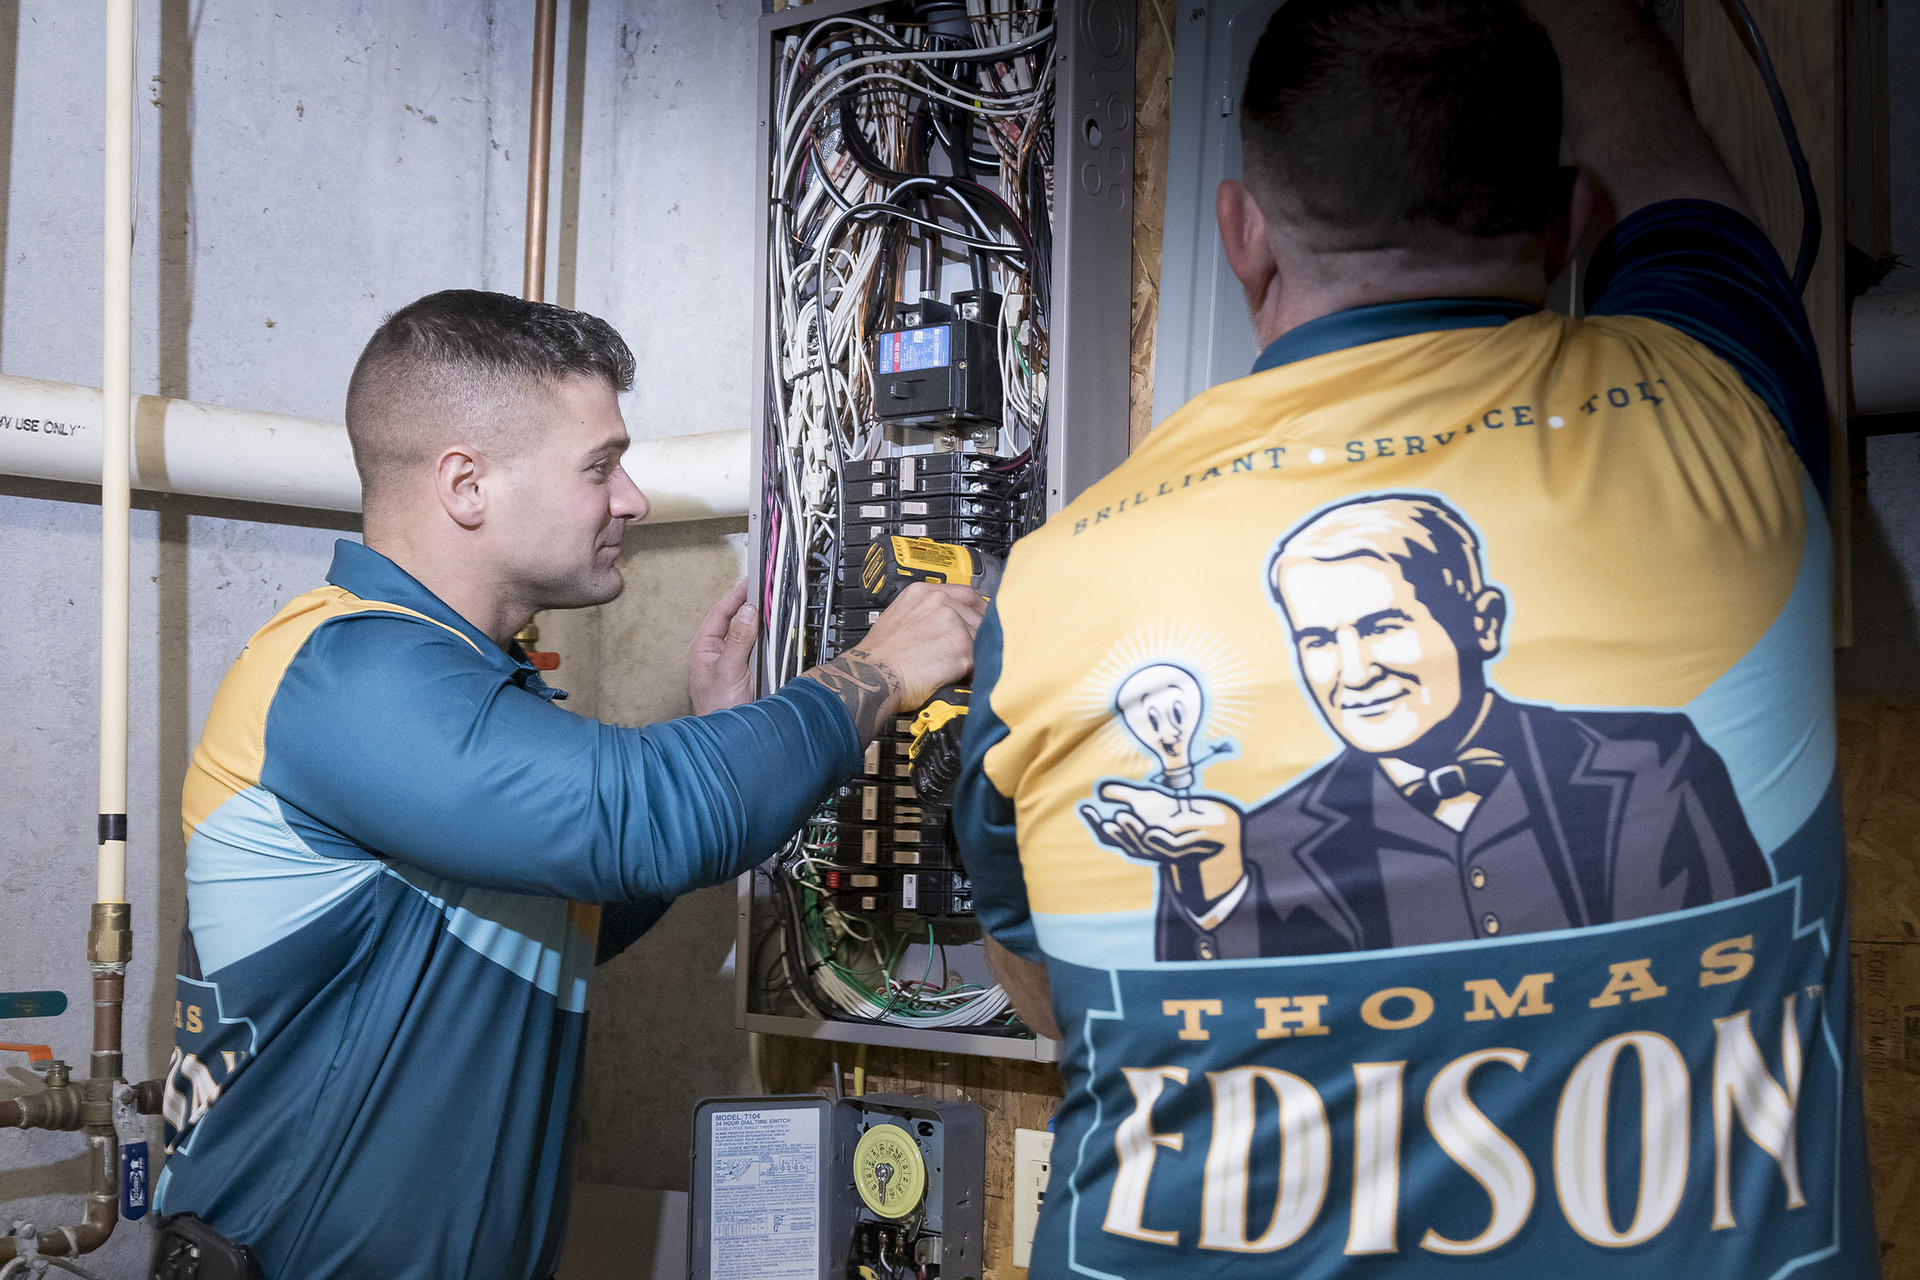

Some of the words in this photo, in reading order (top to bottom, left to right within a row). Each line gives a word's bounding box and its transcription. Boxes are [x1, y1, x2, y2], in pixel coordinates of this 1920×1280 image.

[15, 417, 40, 432] USE
[1072, 446, 1288, 537] BRILLIANT
[1346, 405, 1534, 463] SERVICE
[1162, 935, 1756, 1042] THOMAS
[716, 1113, 743, 1121] MODEL:
[1101, 995, 1807, 1257] EDISON
